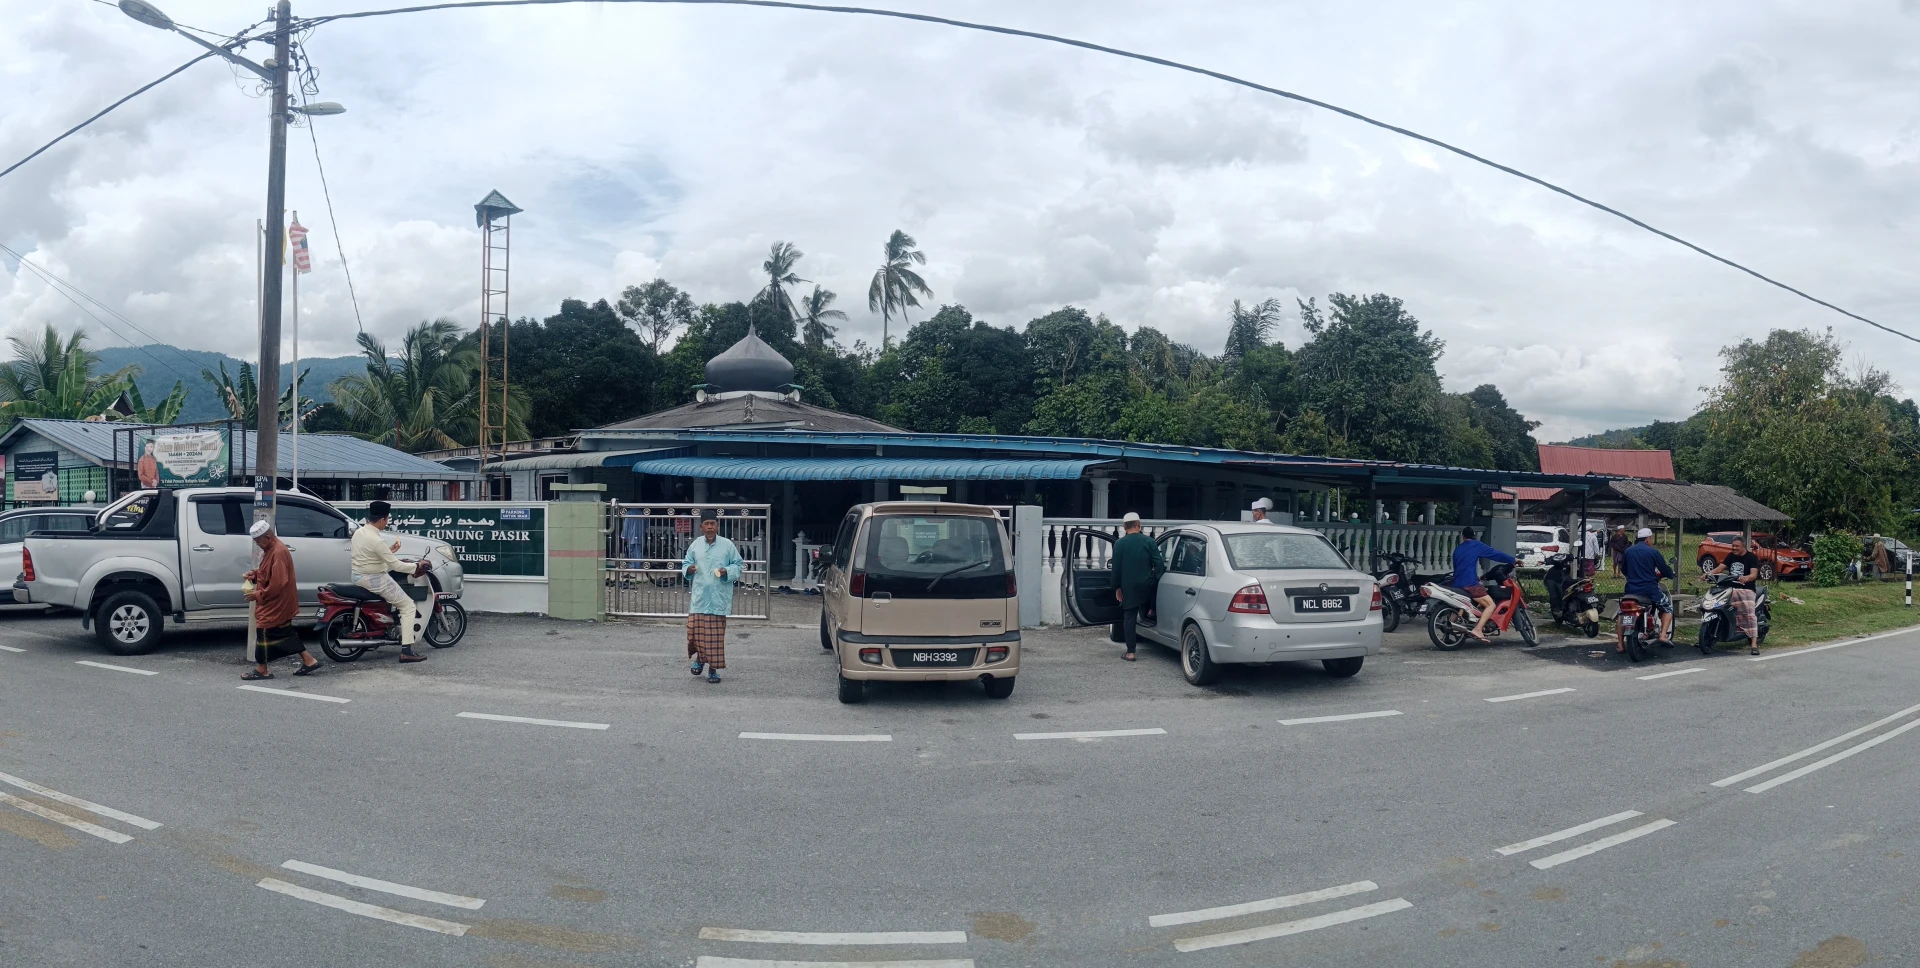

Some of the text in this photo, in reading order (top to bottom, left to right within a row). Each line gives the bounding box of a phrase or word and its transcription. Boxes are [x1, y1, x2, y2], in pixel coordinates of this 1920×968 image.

[457, 517, 495, 529] مسجد
[427, 529, 484, 540] GUNUNG
[491, 530, 530, 541] PASIR
[459, 553, 496, 562] KHUSUS
[1302, 599, 1343, 609] NCL 8862
[913, 652, 958, 662] NBH3392
